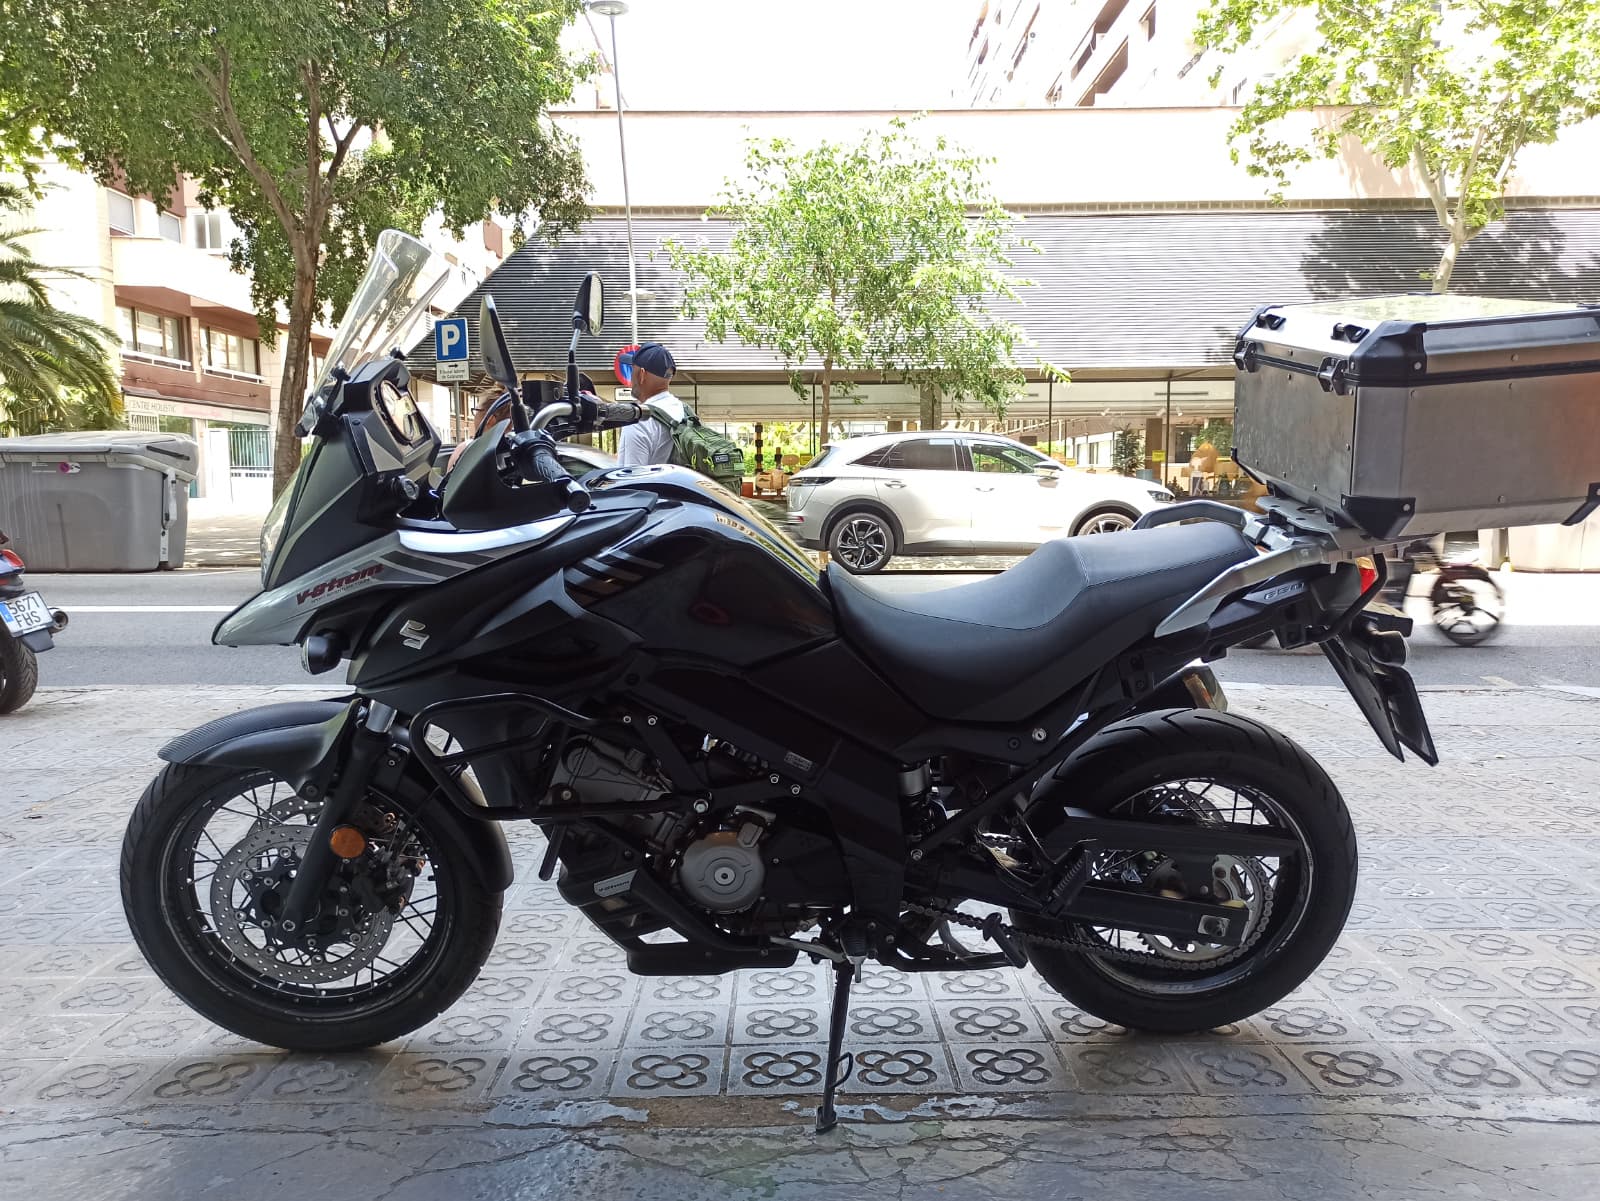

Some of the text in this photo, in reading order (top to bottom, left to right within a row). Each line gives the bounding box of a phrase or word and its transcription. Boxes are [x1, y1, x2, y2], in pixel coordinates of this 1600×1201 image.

[441, 324, 460, 356] P
[6, 596, 40, 615] 5671
[14, 610, 41, 628] FHS
